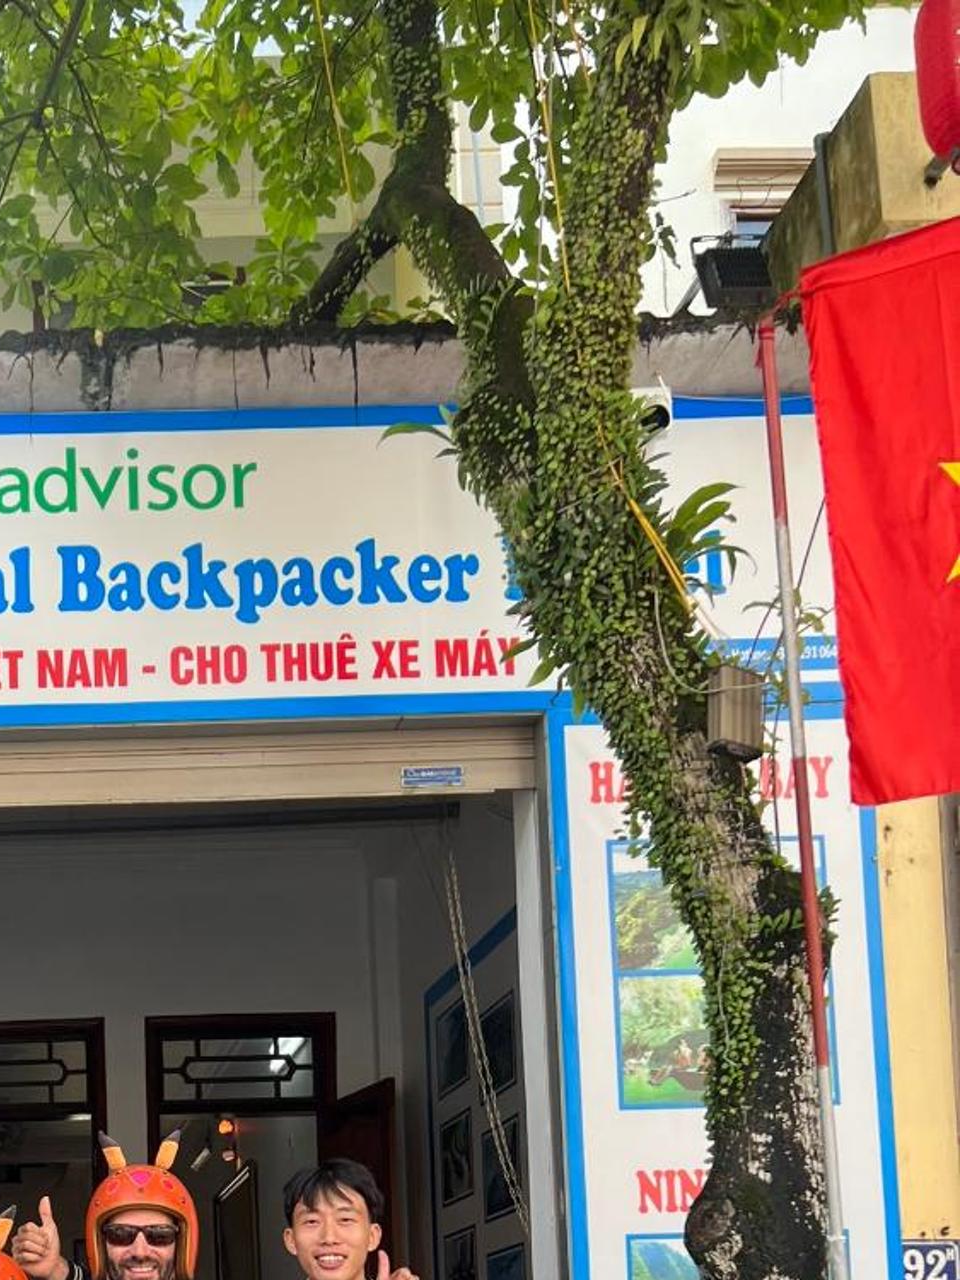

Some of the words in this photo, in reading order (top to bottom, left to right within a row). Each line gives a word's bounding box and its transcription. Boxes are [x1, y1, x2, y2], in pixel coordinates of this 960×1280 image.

[57, 539, 480, 623] Backpacker
[37, 648, 128, 689] NAM
[170, 645, 247, 686] CHO
[259, 634, 358, 682] THUÊ
[372, 640, 421, 680] XE
[435, 629, 520, 678] MÁY
